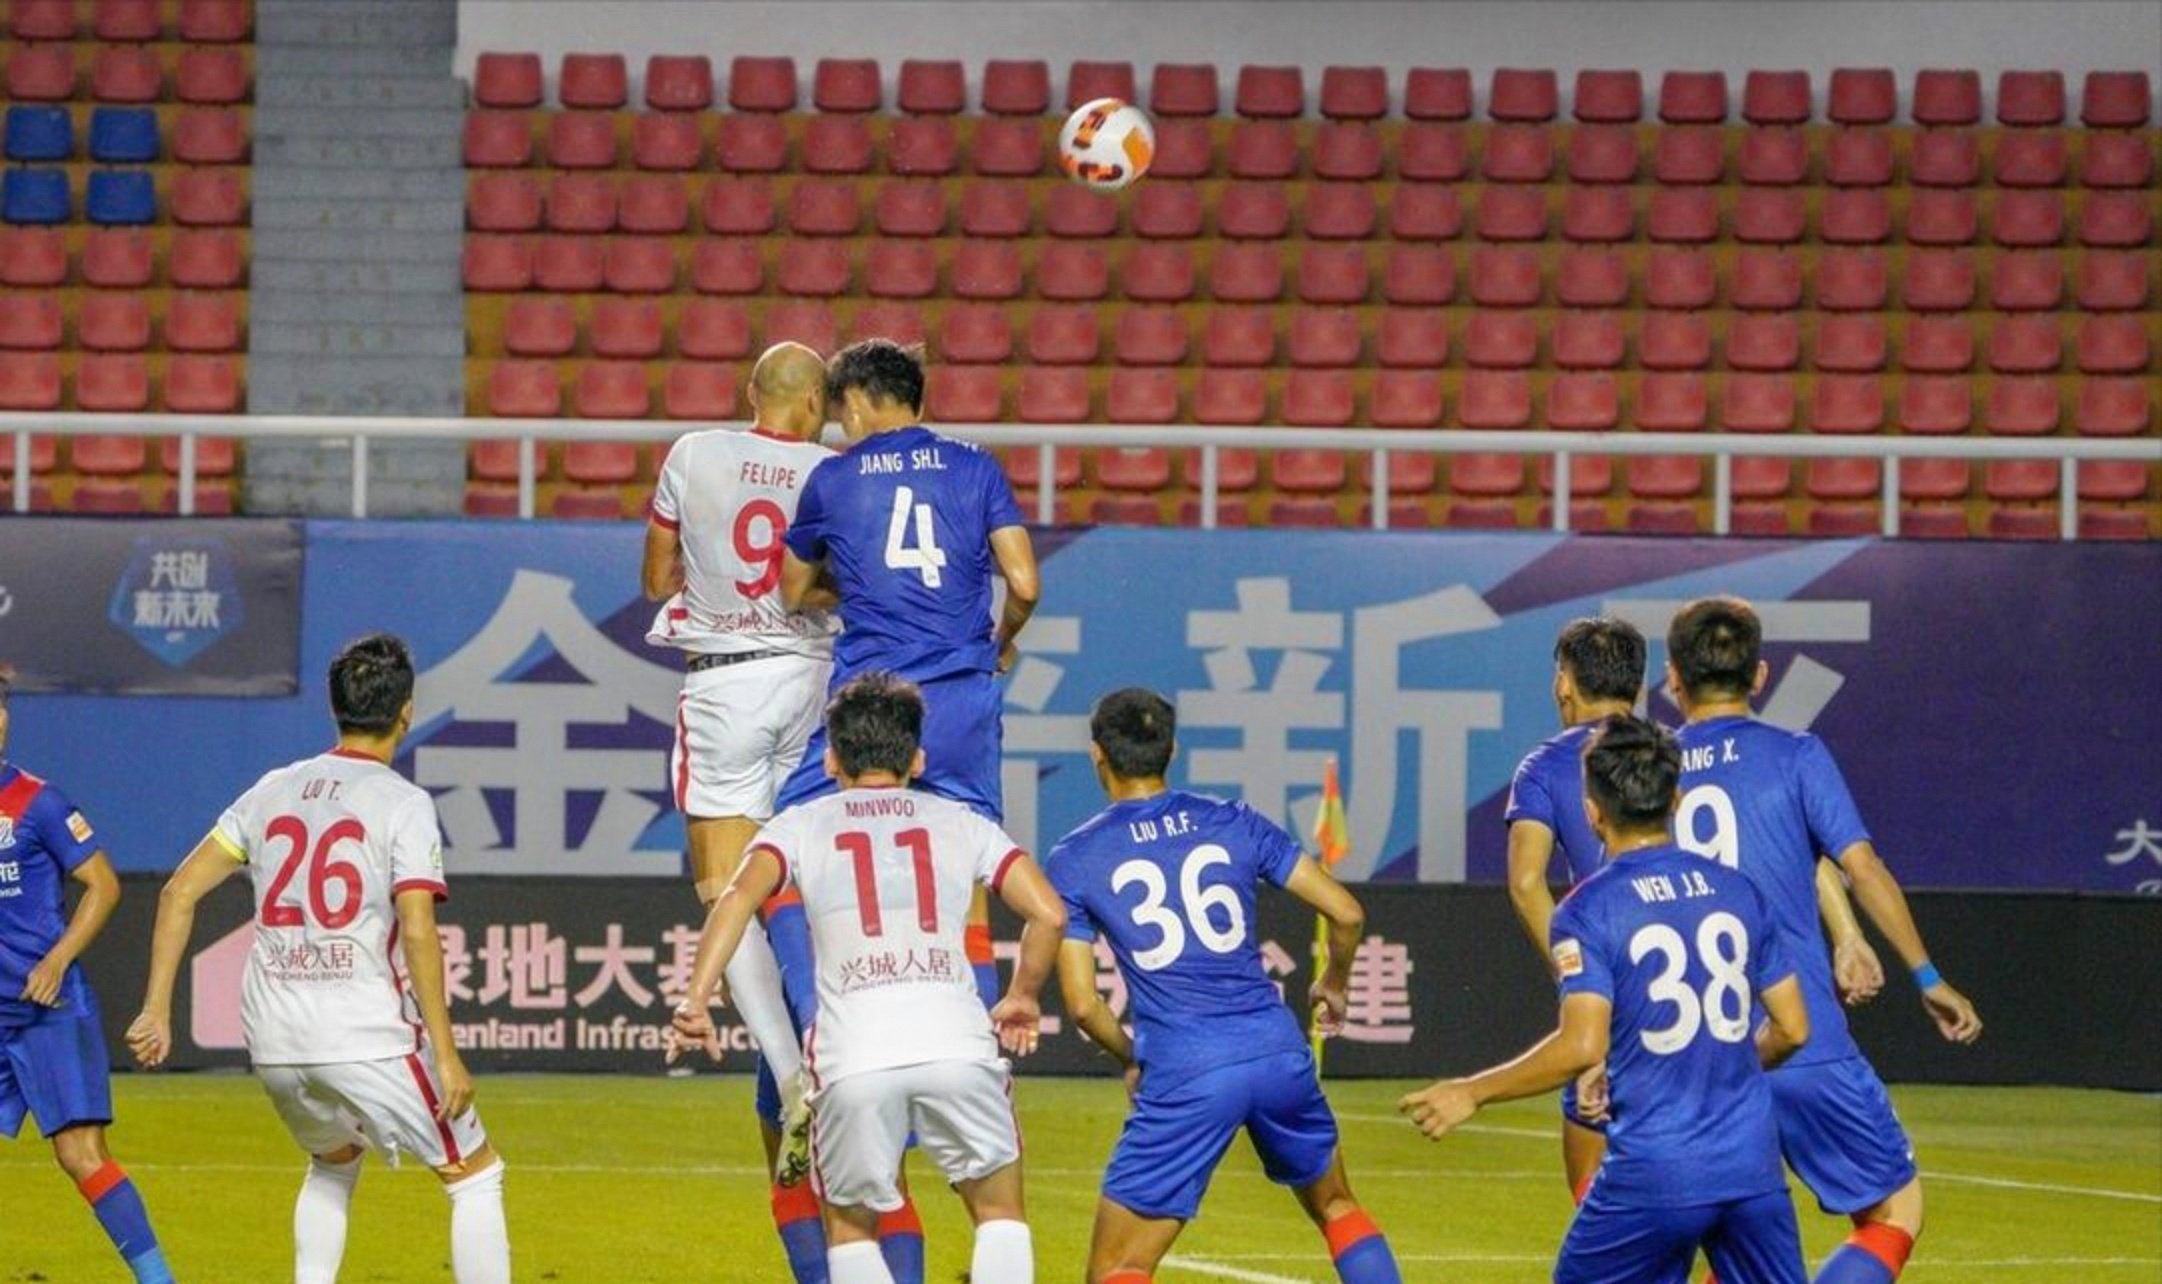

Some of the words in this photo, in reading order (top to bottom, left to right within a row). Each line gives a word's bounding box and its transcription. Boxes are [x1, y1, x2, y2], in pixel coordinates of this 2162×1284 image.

[741, 462, 796, 490] FELIPE
[860, 454, 902, 474] JIANG
[733, 499, 787, 599] 9
[884, 486, 946, 588] 4
[151, 552, 208, 588] 共创
[133, 590, 221, 628] 新未来
[1681, 745, 1715, 772] ANG
[1723, 738, 1739, 763] X.
[302, 779, 324, 800] LIU
[845, 798, 914, 817] MINWOO
[1130, 821, 1157, 843] LIU
[1164, 812, 1198, 836] R.F.
[1675, 784, 1738, 869] 9
[262, 815, 365, 930] 26
[834, 827, 938, 936] 11
[1632, 876, 1676, 903] WEN
[1682, 870, 1716, 895] J.B.
[1111, 844, 1246, 971] 36
[839, 948, 951, 986] 兴城人居
[1629, 911, 1751, 1055] 38
